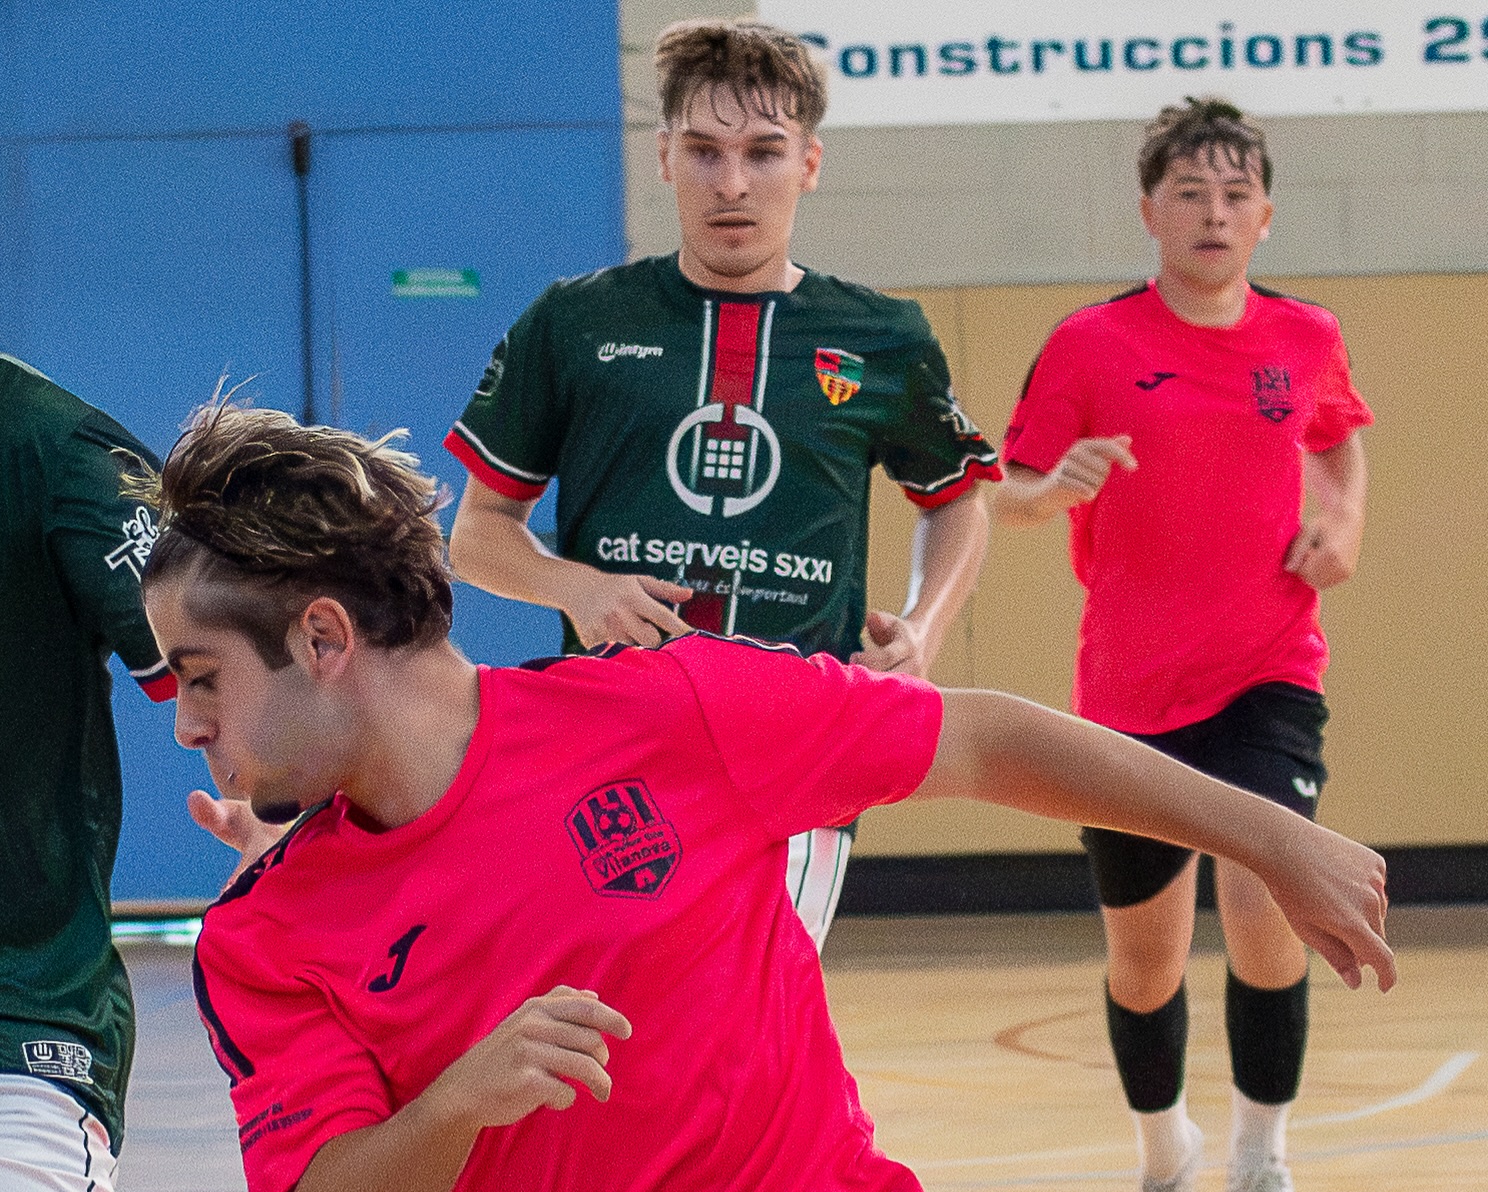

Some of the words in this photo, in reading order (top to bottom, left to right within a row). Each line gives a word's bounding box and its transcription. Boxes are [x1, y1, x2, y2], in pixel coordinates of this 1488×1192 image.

[800, 22, 1386, 78] onstruccions
[1423, 16, 1488, 64] 2
[597, 533, 641, 562] cat
[644, 539, 768, 574] serveis
